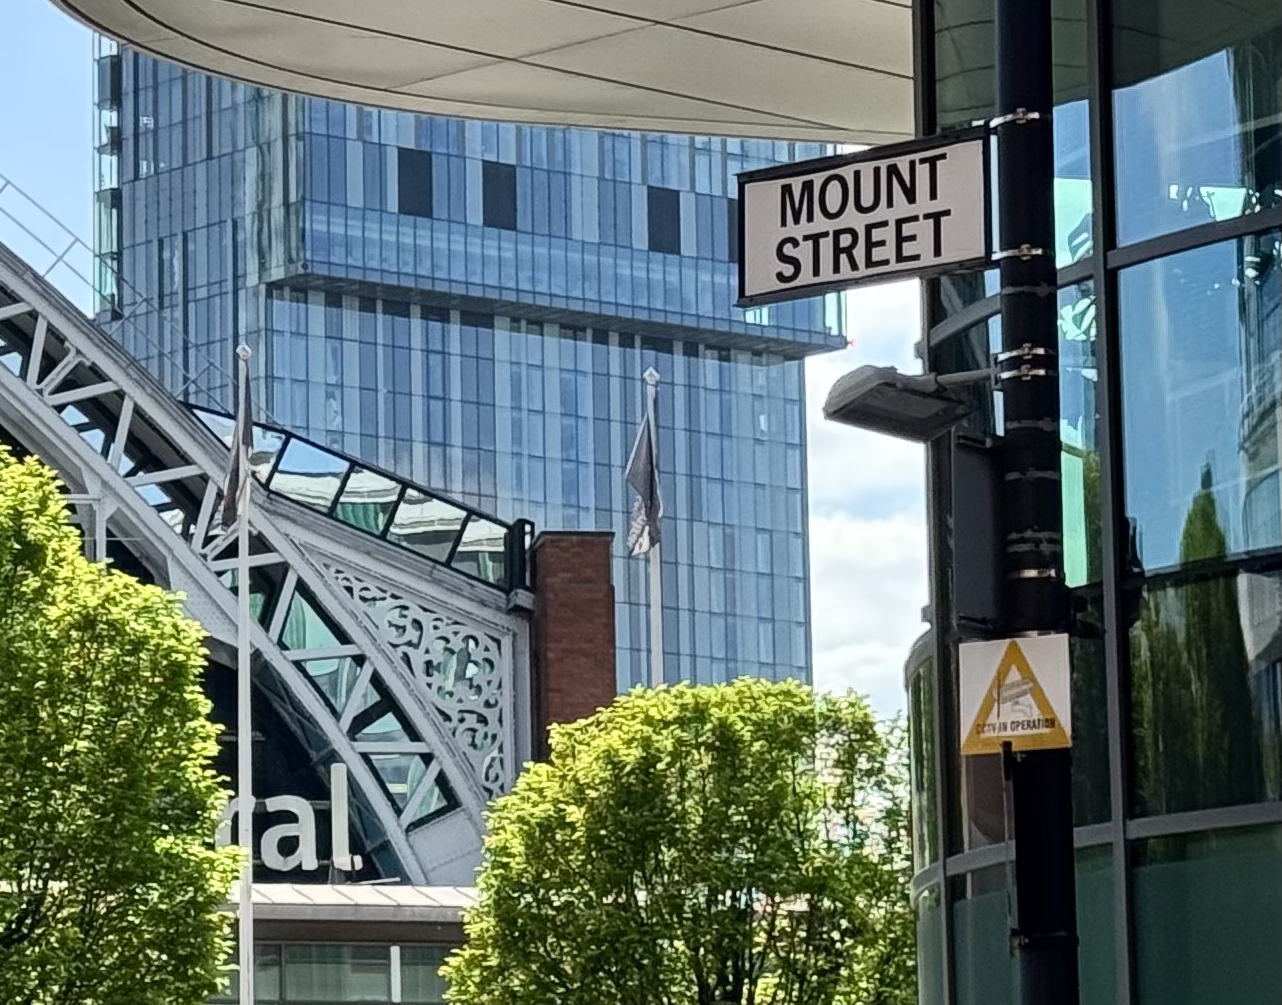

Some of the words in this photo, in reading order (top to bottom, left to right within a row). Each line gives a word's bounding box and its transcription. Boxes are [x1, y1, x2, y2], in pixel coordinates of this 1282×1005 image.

[779, 152, 948, 229] MOUNT
[775, 208, 952, 285] STREET
[998, 721, 1008, 734] IN
[1010, 717, 1056, 732] OPERATION
